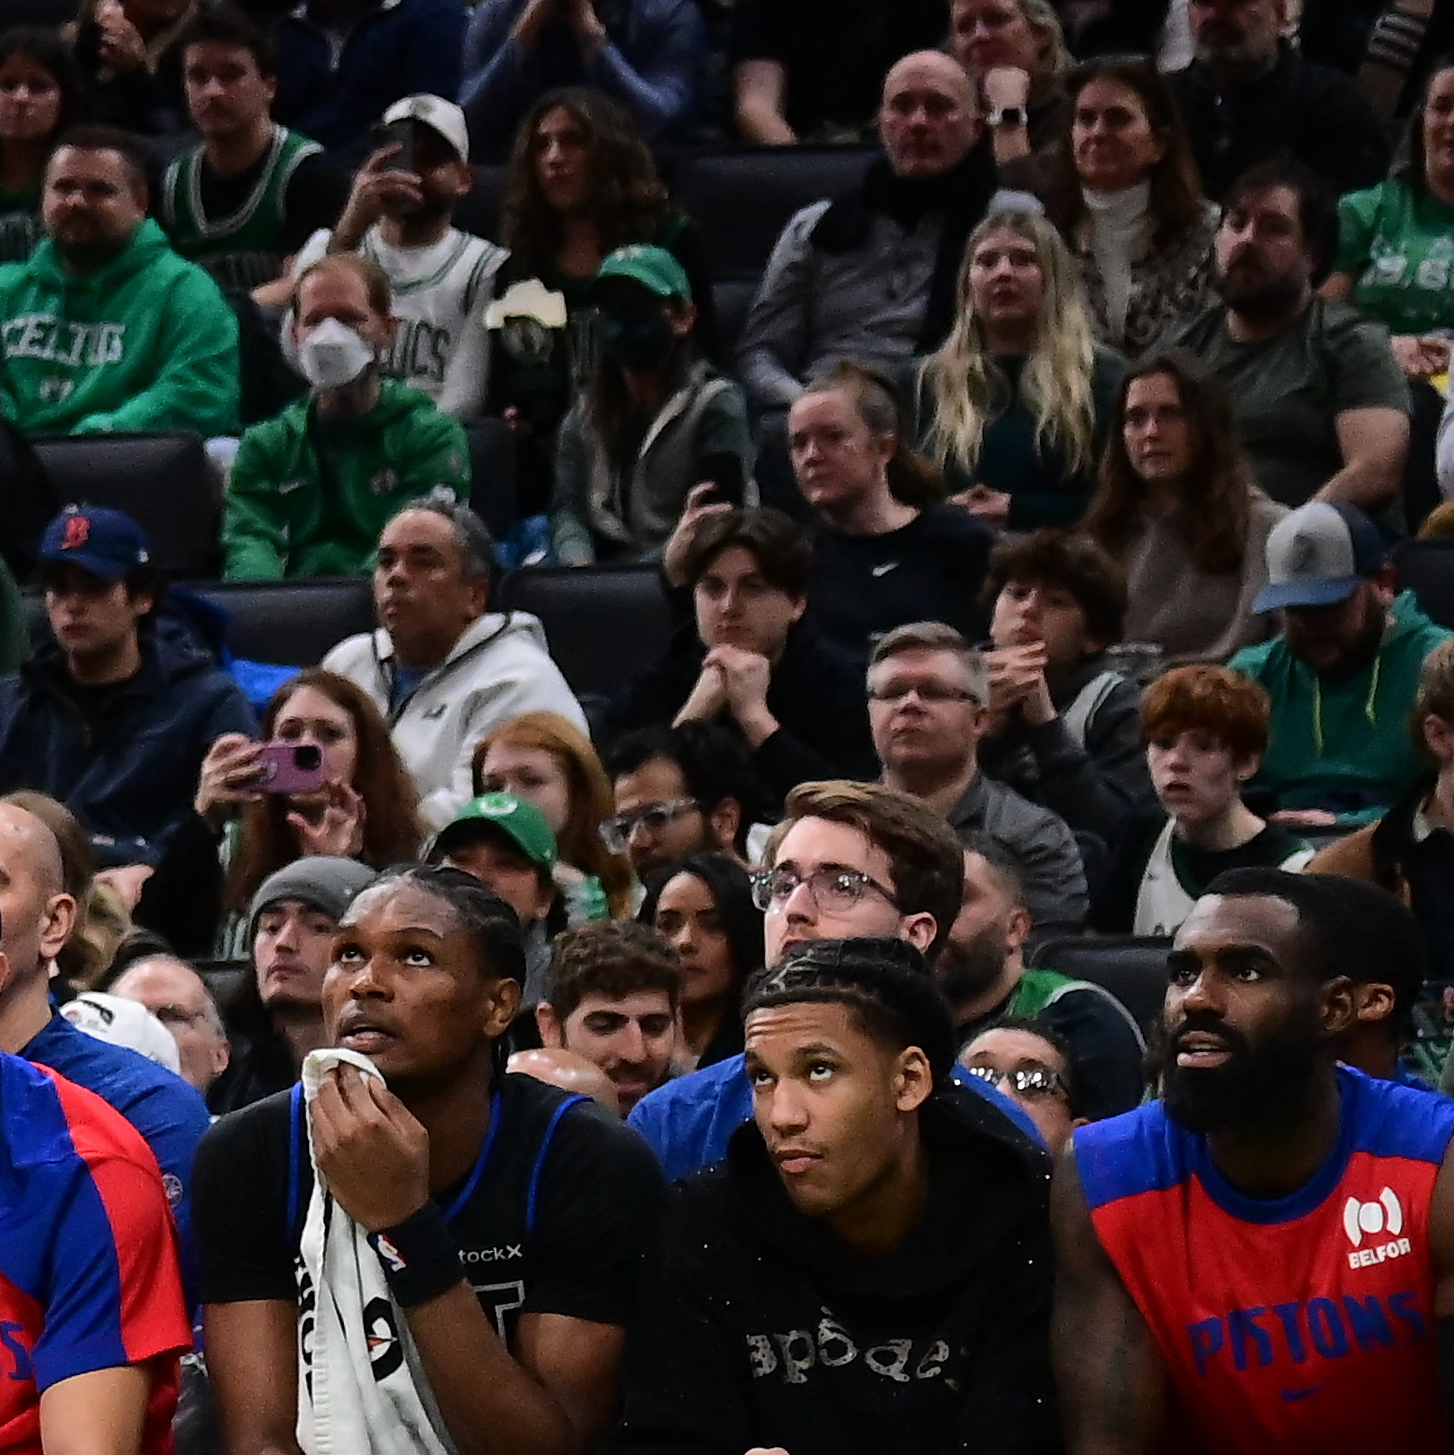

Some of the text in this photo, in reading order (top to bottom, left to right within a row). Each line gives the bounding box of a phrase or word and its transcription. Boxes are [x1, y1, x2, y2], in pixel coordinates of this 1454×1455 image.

[458, 1243, 524, 1266] tockX
[1347, 1237, 1412, 1270] BELFOR
[1185, 1290, 1431, 1379] PISTONS
